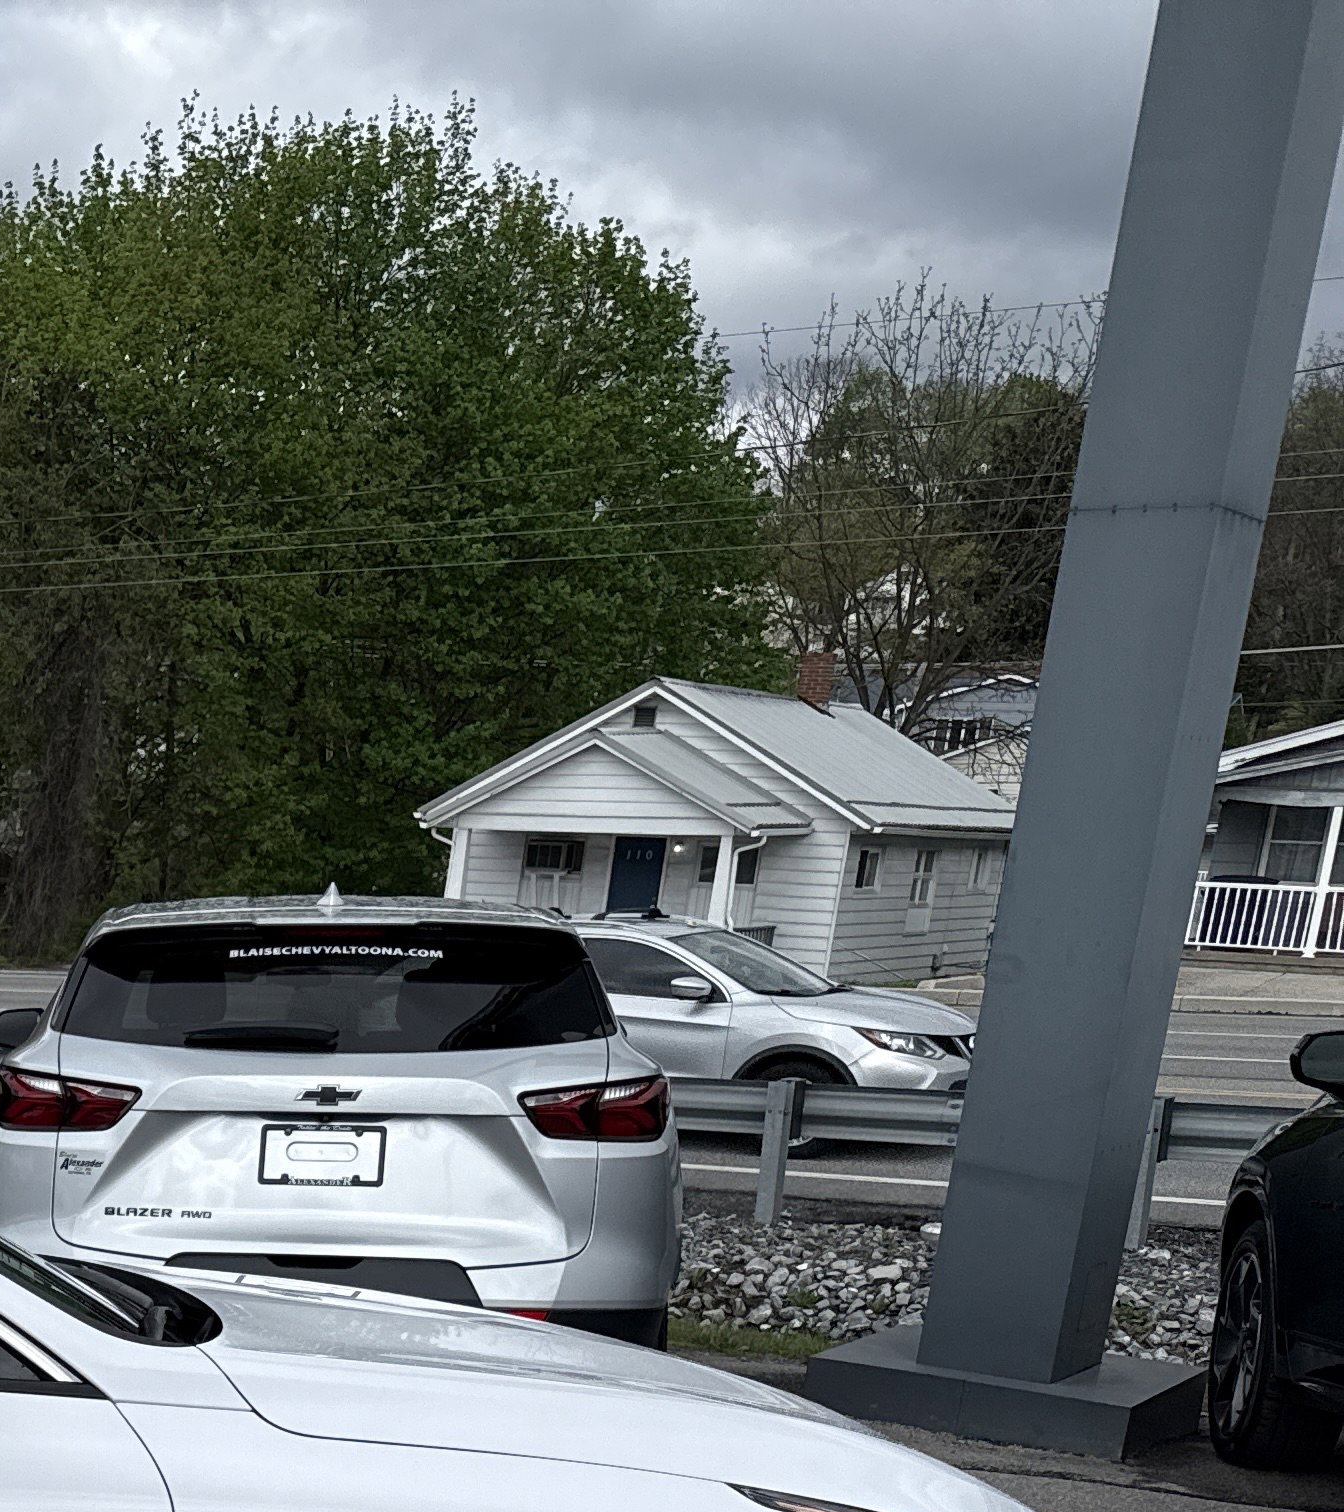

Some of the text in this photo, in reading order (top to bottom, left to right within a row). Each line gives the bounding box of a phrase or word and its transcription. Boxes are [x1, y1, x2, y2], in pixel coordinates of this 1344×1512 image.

[228, 945, 444, 959] BLAISECHEVYALTOONA.COM
[104, 1206, 212, 1219] BLAZER AWD
